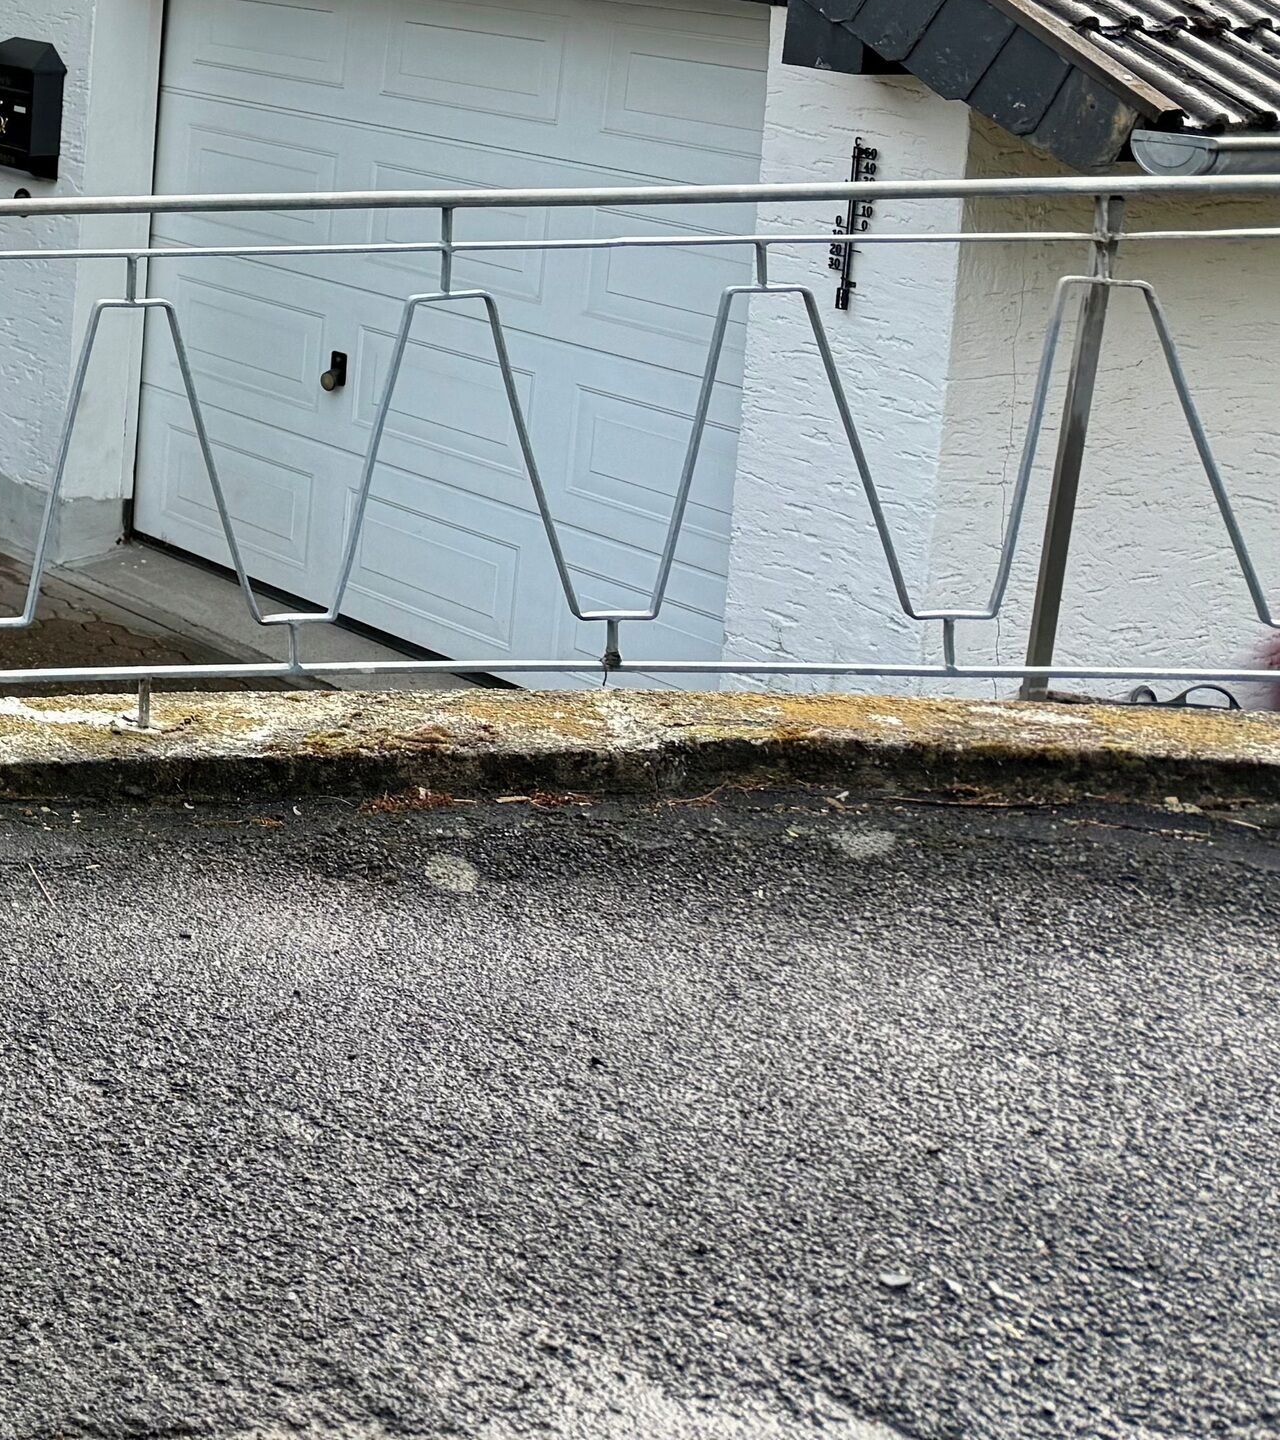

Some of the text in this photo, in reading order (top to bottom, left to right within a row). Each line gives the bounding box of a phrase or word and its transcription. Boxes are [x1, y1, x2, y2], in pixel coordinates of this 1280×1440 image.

[865, 147, 878, 160] 50
[864, 162, 877, 174] 40
[861, 205, 873, 218] 10
[835, 215, 842, 226] 0
[861, 220, 868, 231] 0
[830, 243, 842, 255] 20
[828, 257, 841, 269] 30
